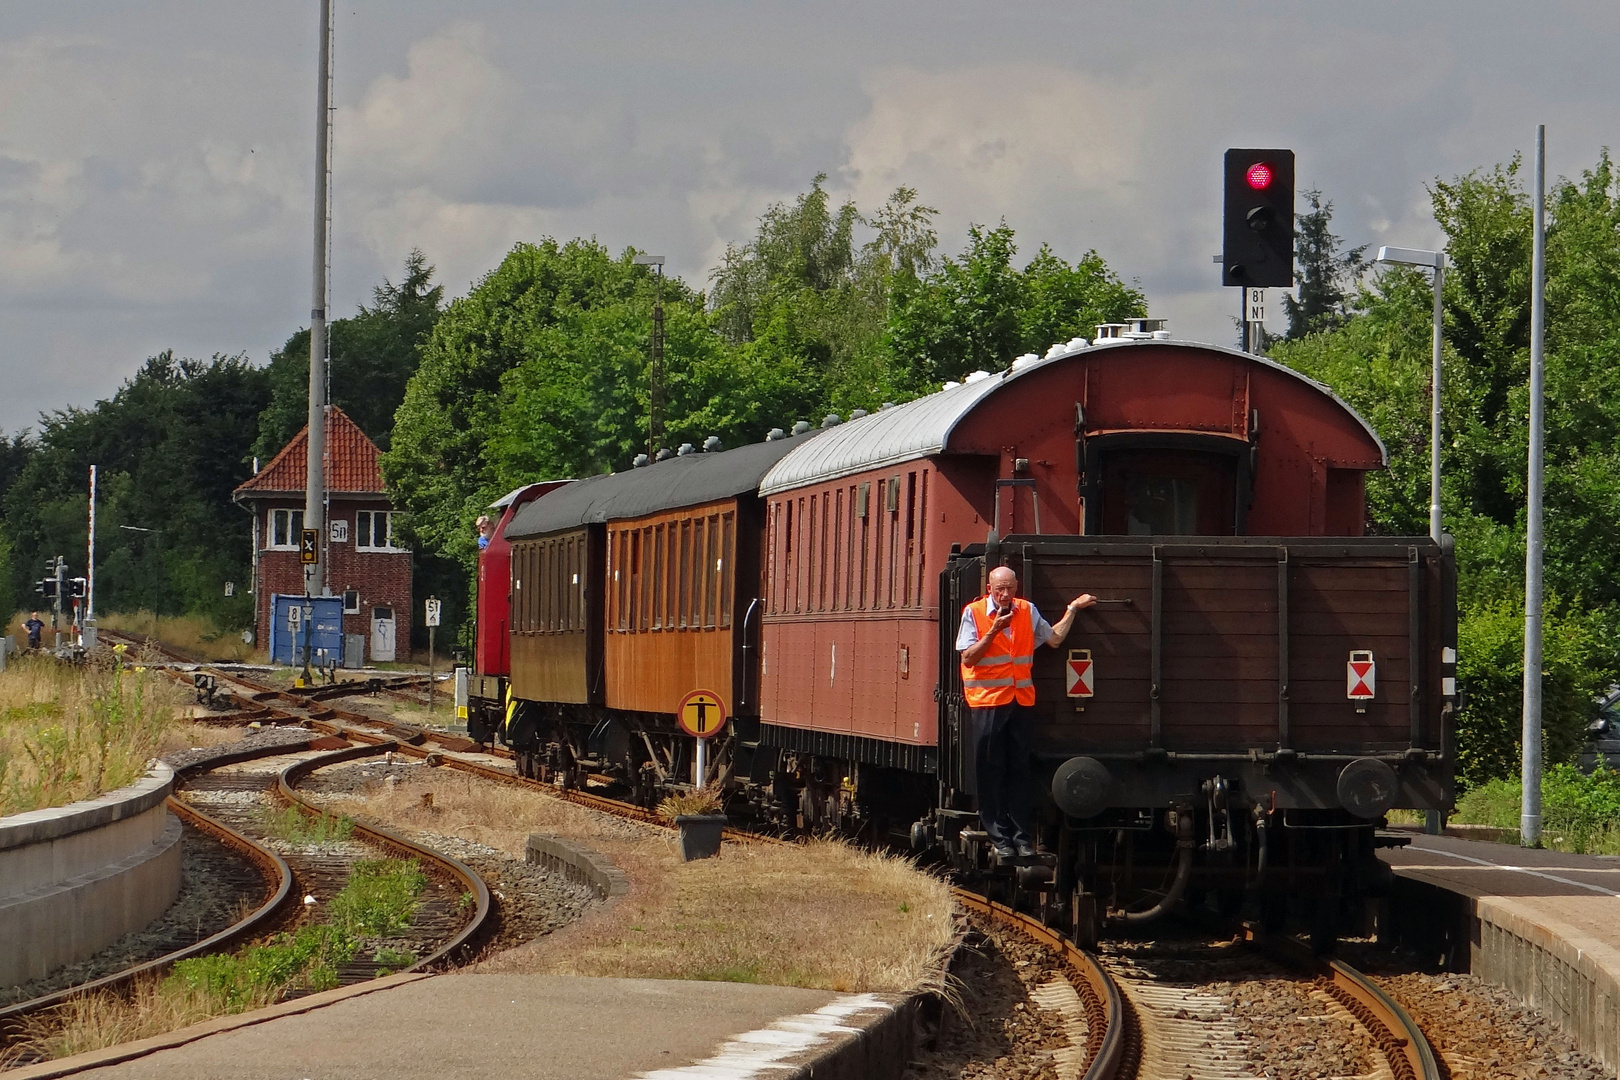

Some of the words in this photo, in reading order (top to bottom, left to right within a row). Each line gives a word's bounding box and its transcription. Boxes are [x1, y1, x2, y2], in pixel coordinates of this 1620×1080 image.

[1252, 290, 1264, 302] 81
[1252, 306, 1264, 319] N1
[332, 523, 346, 539] Sn
[292, 608, 298, 620] 8
